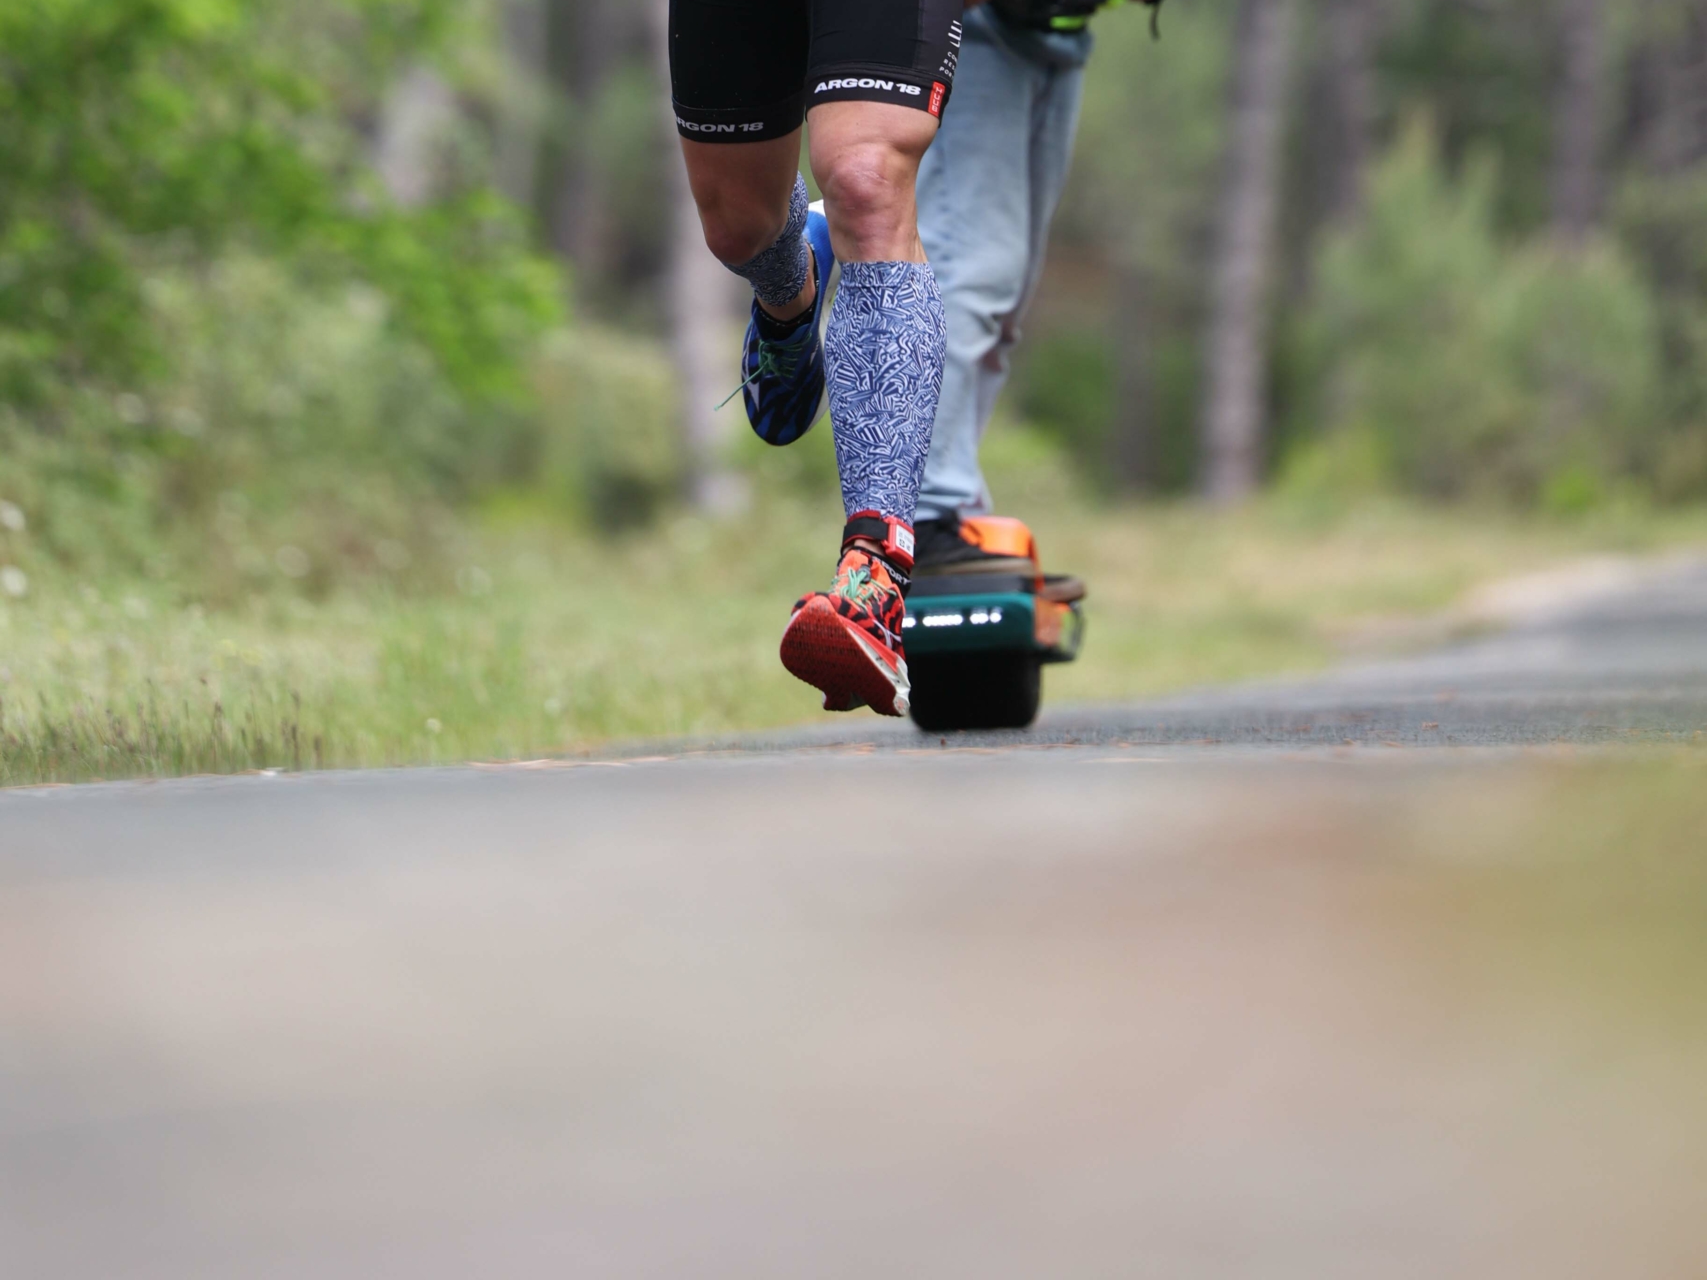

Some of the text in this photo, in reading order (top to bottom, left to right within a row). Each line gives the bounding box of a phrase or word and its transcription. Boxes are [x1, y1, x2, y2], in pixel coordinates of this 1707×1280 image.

[813, 78, 922, 96] ARGON 18
[676, 116, 764, 132] RGON 18
